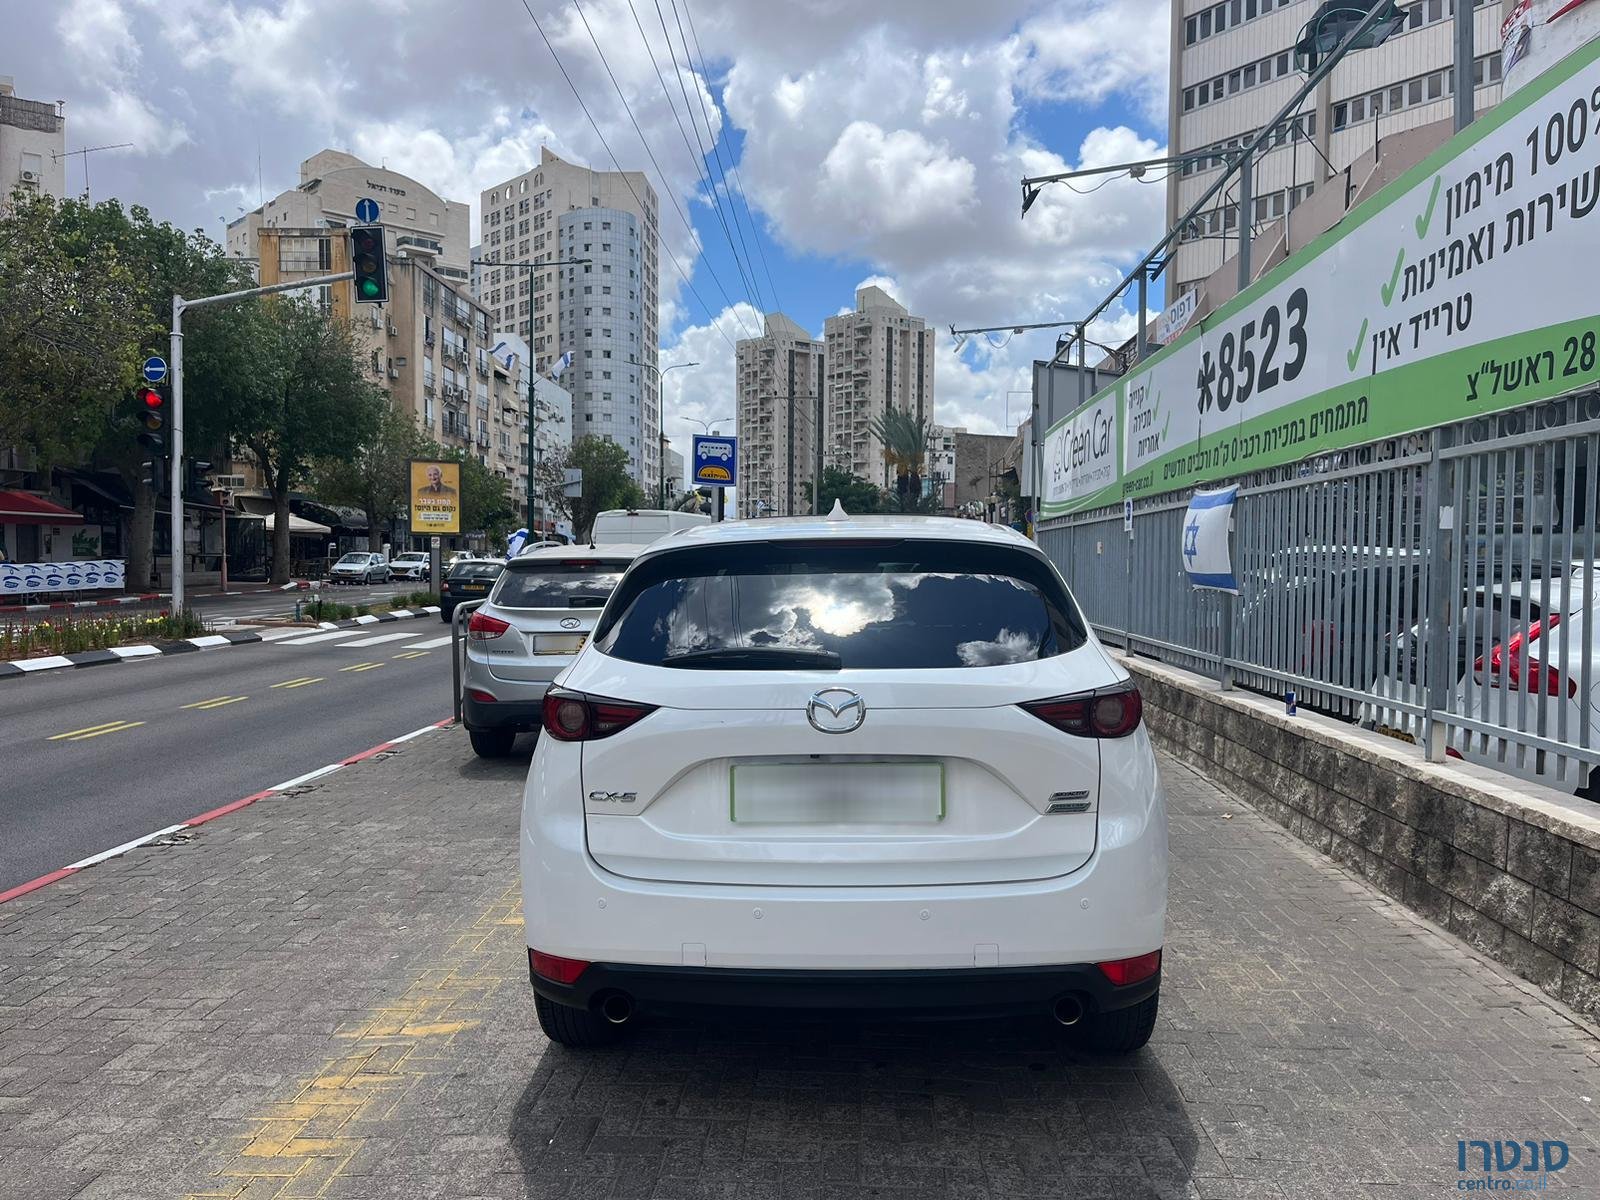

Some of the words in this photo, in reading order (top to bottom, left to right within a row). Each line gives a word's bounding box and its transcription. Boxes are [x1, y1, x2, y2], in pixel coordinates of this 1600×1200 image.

[1446, 151, 1514, 236] מימון
[1503, 164, 1600, 253] שירות
[1402, 221, 1494, 302] ואמינות
[1170, 296, 1191, 324] דפוס
[1409, 292, 1472, 349] טרייד
[1371, 322, 1401, 375] אין
[1563, 330, 1595, 376] 28
[1133, 408, 1152, 433] מכירה
[1310, 395, 1368, 439] מתמחים
[1064, 427, 1090, 472] Green
[1092, 409, 1113, 458] Car
[1137, 432, 1160, 458] אחריות
[1231, 437, 1238, 462] 0
[1240, 434, 1260, 459] רכבי
[1263, 417, 1305, 453] במכירת
[1163, 457, 1186, 480] חדשים
[1187, 449, 1211, 474] ורכבים
[1122, 470, 1154, 497] green-car.co.il
[589, 791, 637, 803] CX-5
